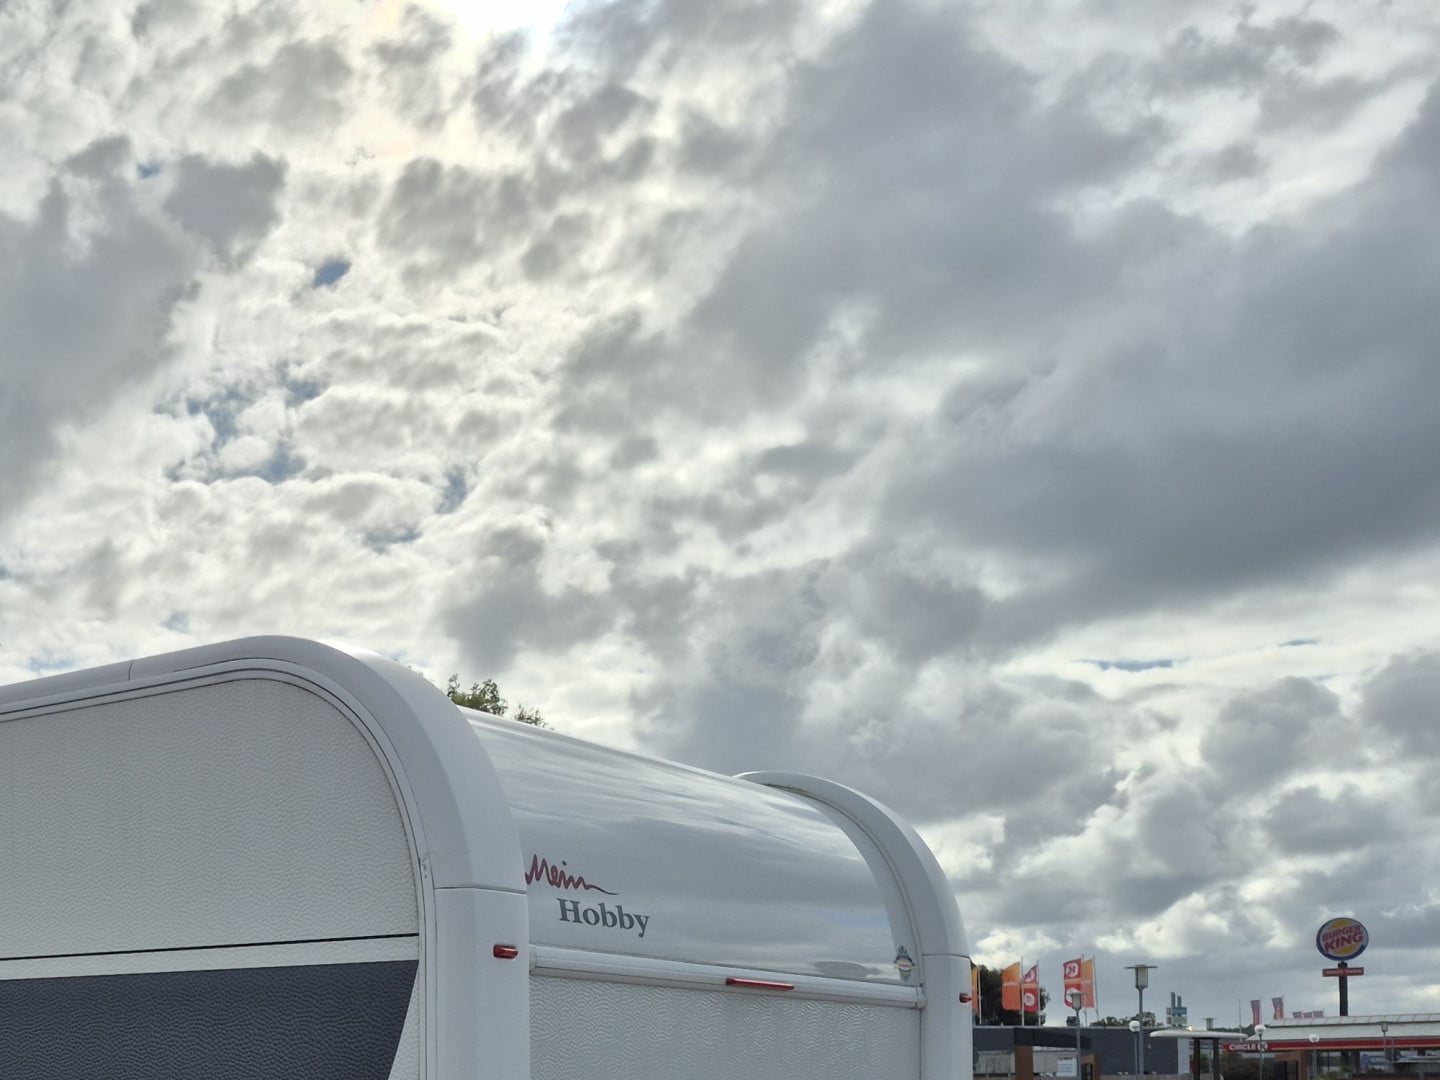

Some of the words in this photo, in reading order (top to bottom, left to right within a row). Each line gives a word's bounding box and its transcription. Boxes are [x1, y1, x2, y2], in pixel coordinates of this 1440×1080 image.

[525, 854, 619, 895] Mein
[557, 898, 650, 938] Hobby
[1322, 925, 1362, 942] BURGER
[1324, 932, 1364, 953] KING
[1229, 1043, 1257, 1052] CIRCLE
